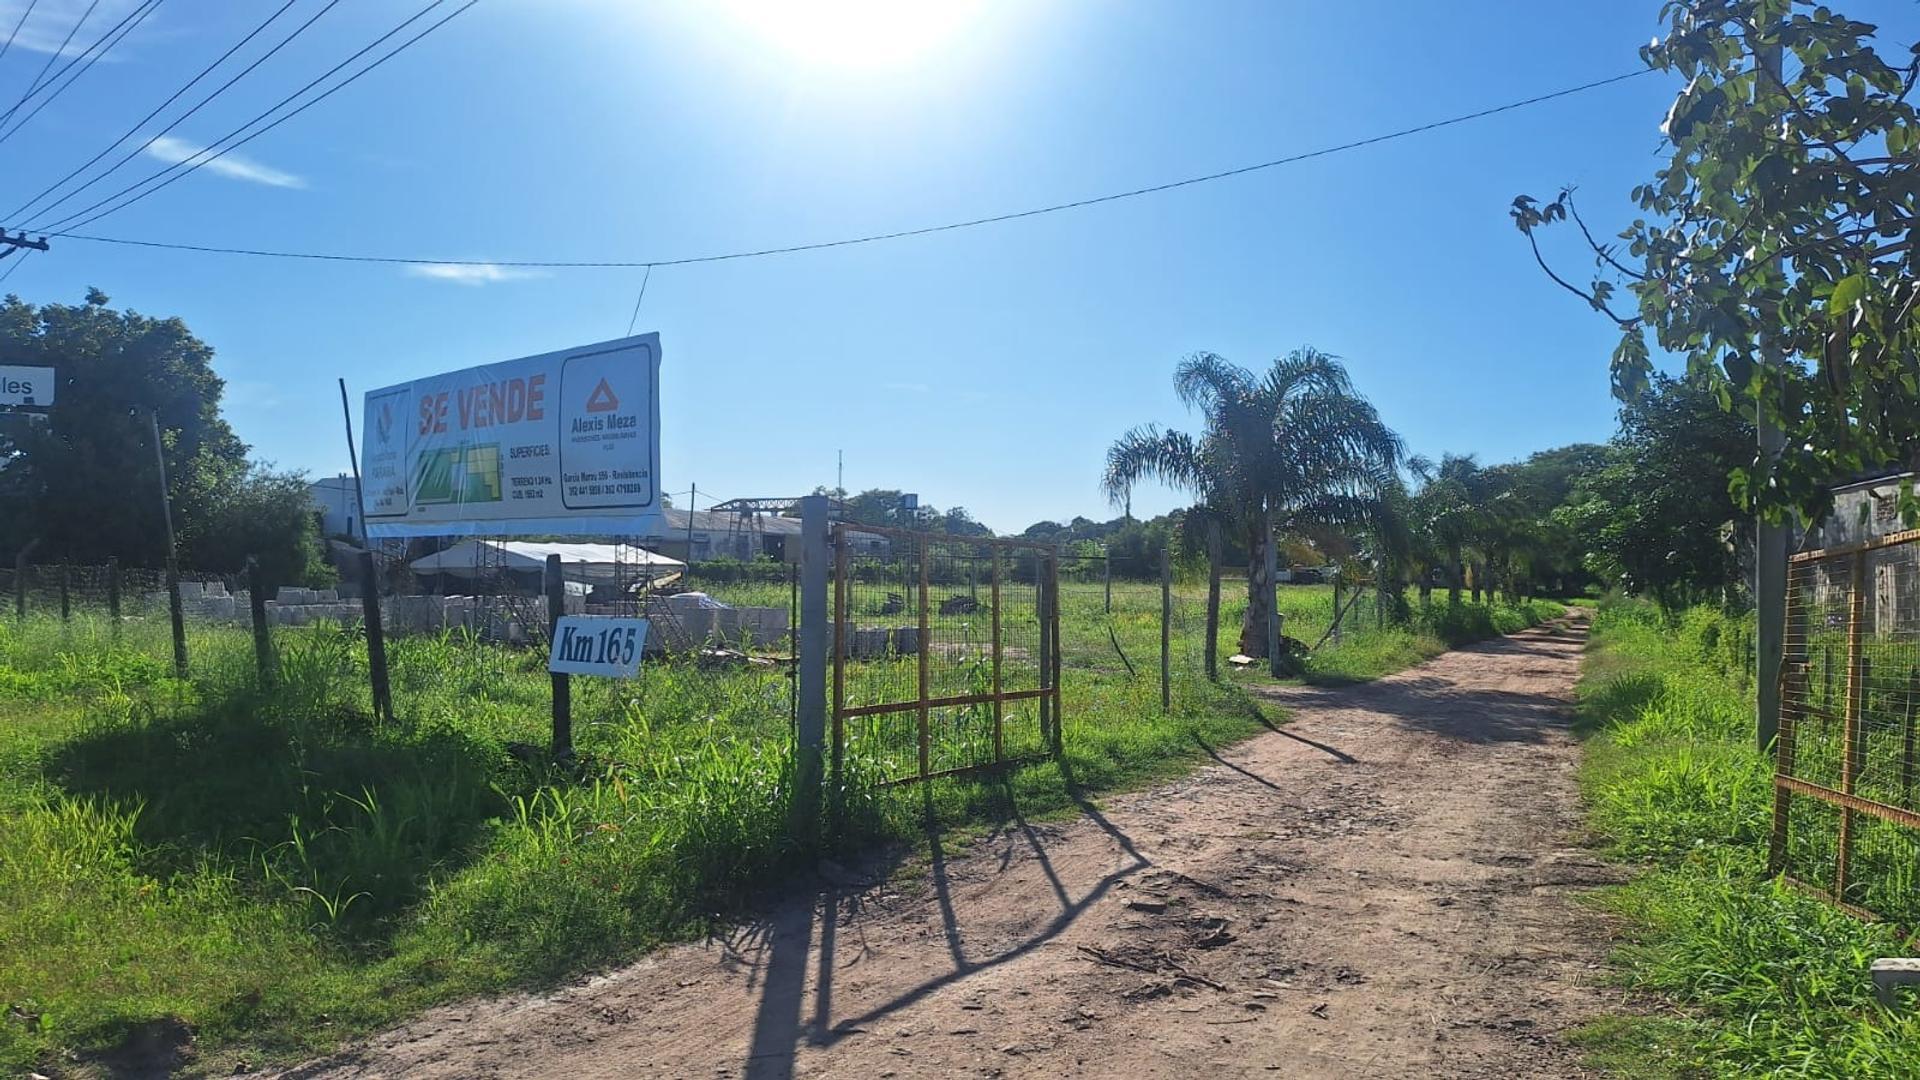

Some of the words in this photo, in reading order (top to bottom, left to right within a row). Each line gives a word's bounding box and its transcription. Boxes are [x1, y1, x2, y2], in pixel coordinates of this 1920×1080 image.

[418, 392, 449, 435] SE
[457, 374, 546, 430] VENDE
[571, 416, 604, 433] Alexis
[607, 414, 637, 430] Meza
[558, 626, 594, 663] Km
[594, 627, 637, 666] 165
